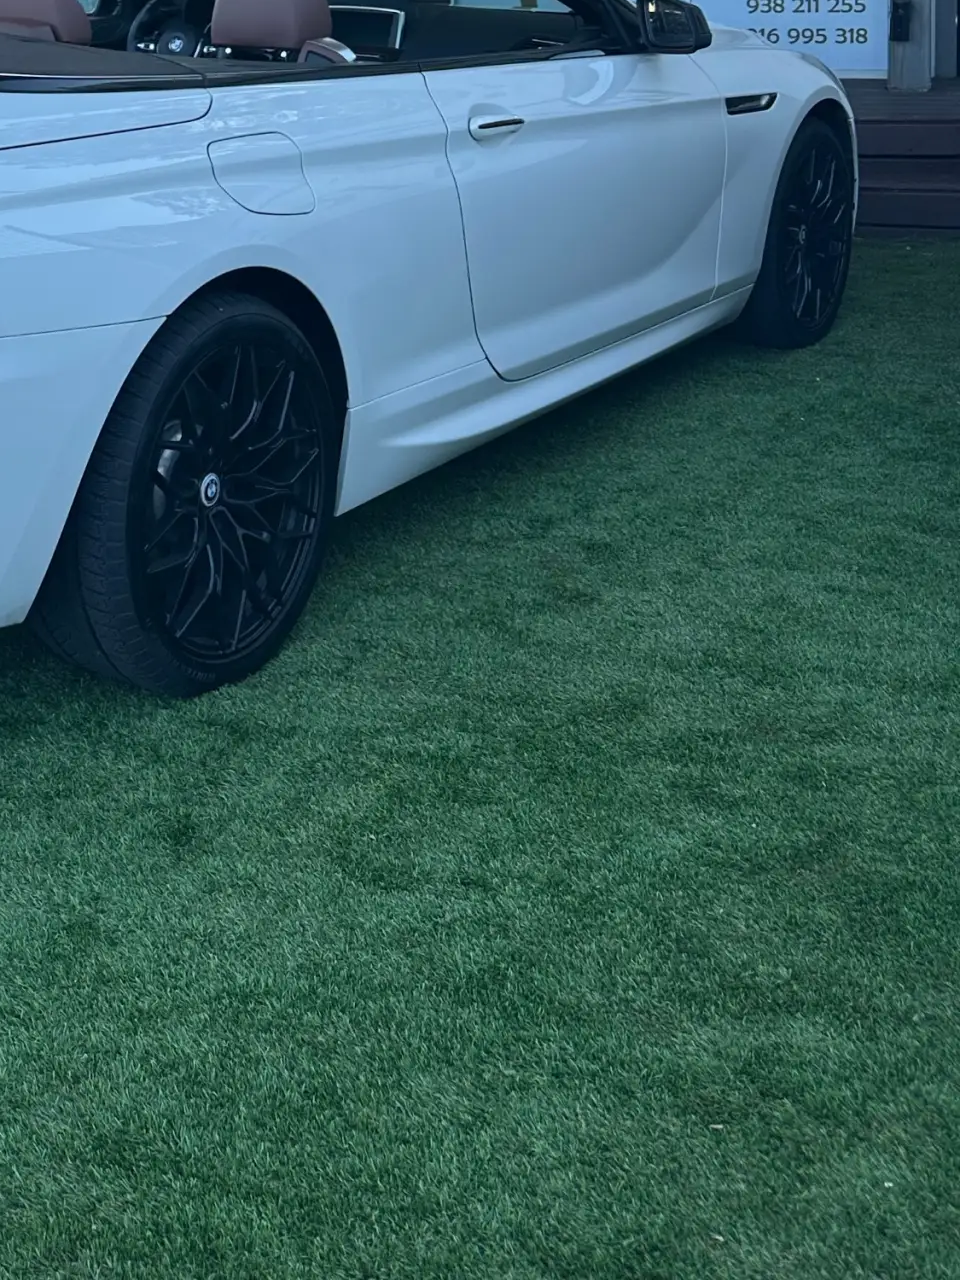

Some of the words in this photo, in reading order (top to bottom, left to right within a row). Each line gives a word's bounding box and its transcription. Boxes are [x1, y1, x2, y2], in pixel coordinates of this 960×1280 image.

[746, 28, 780, 44] 16
[787, 28, 827, 44] 995
[835, 28, 868, 44] 318
